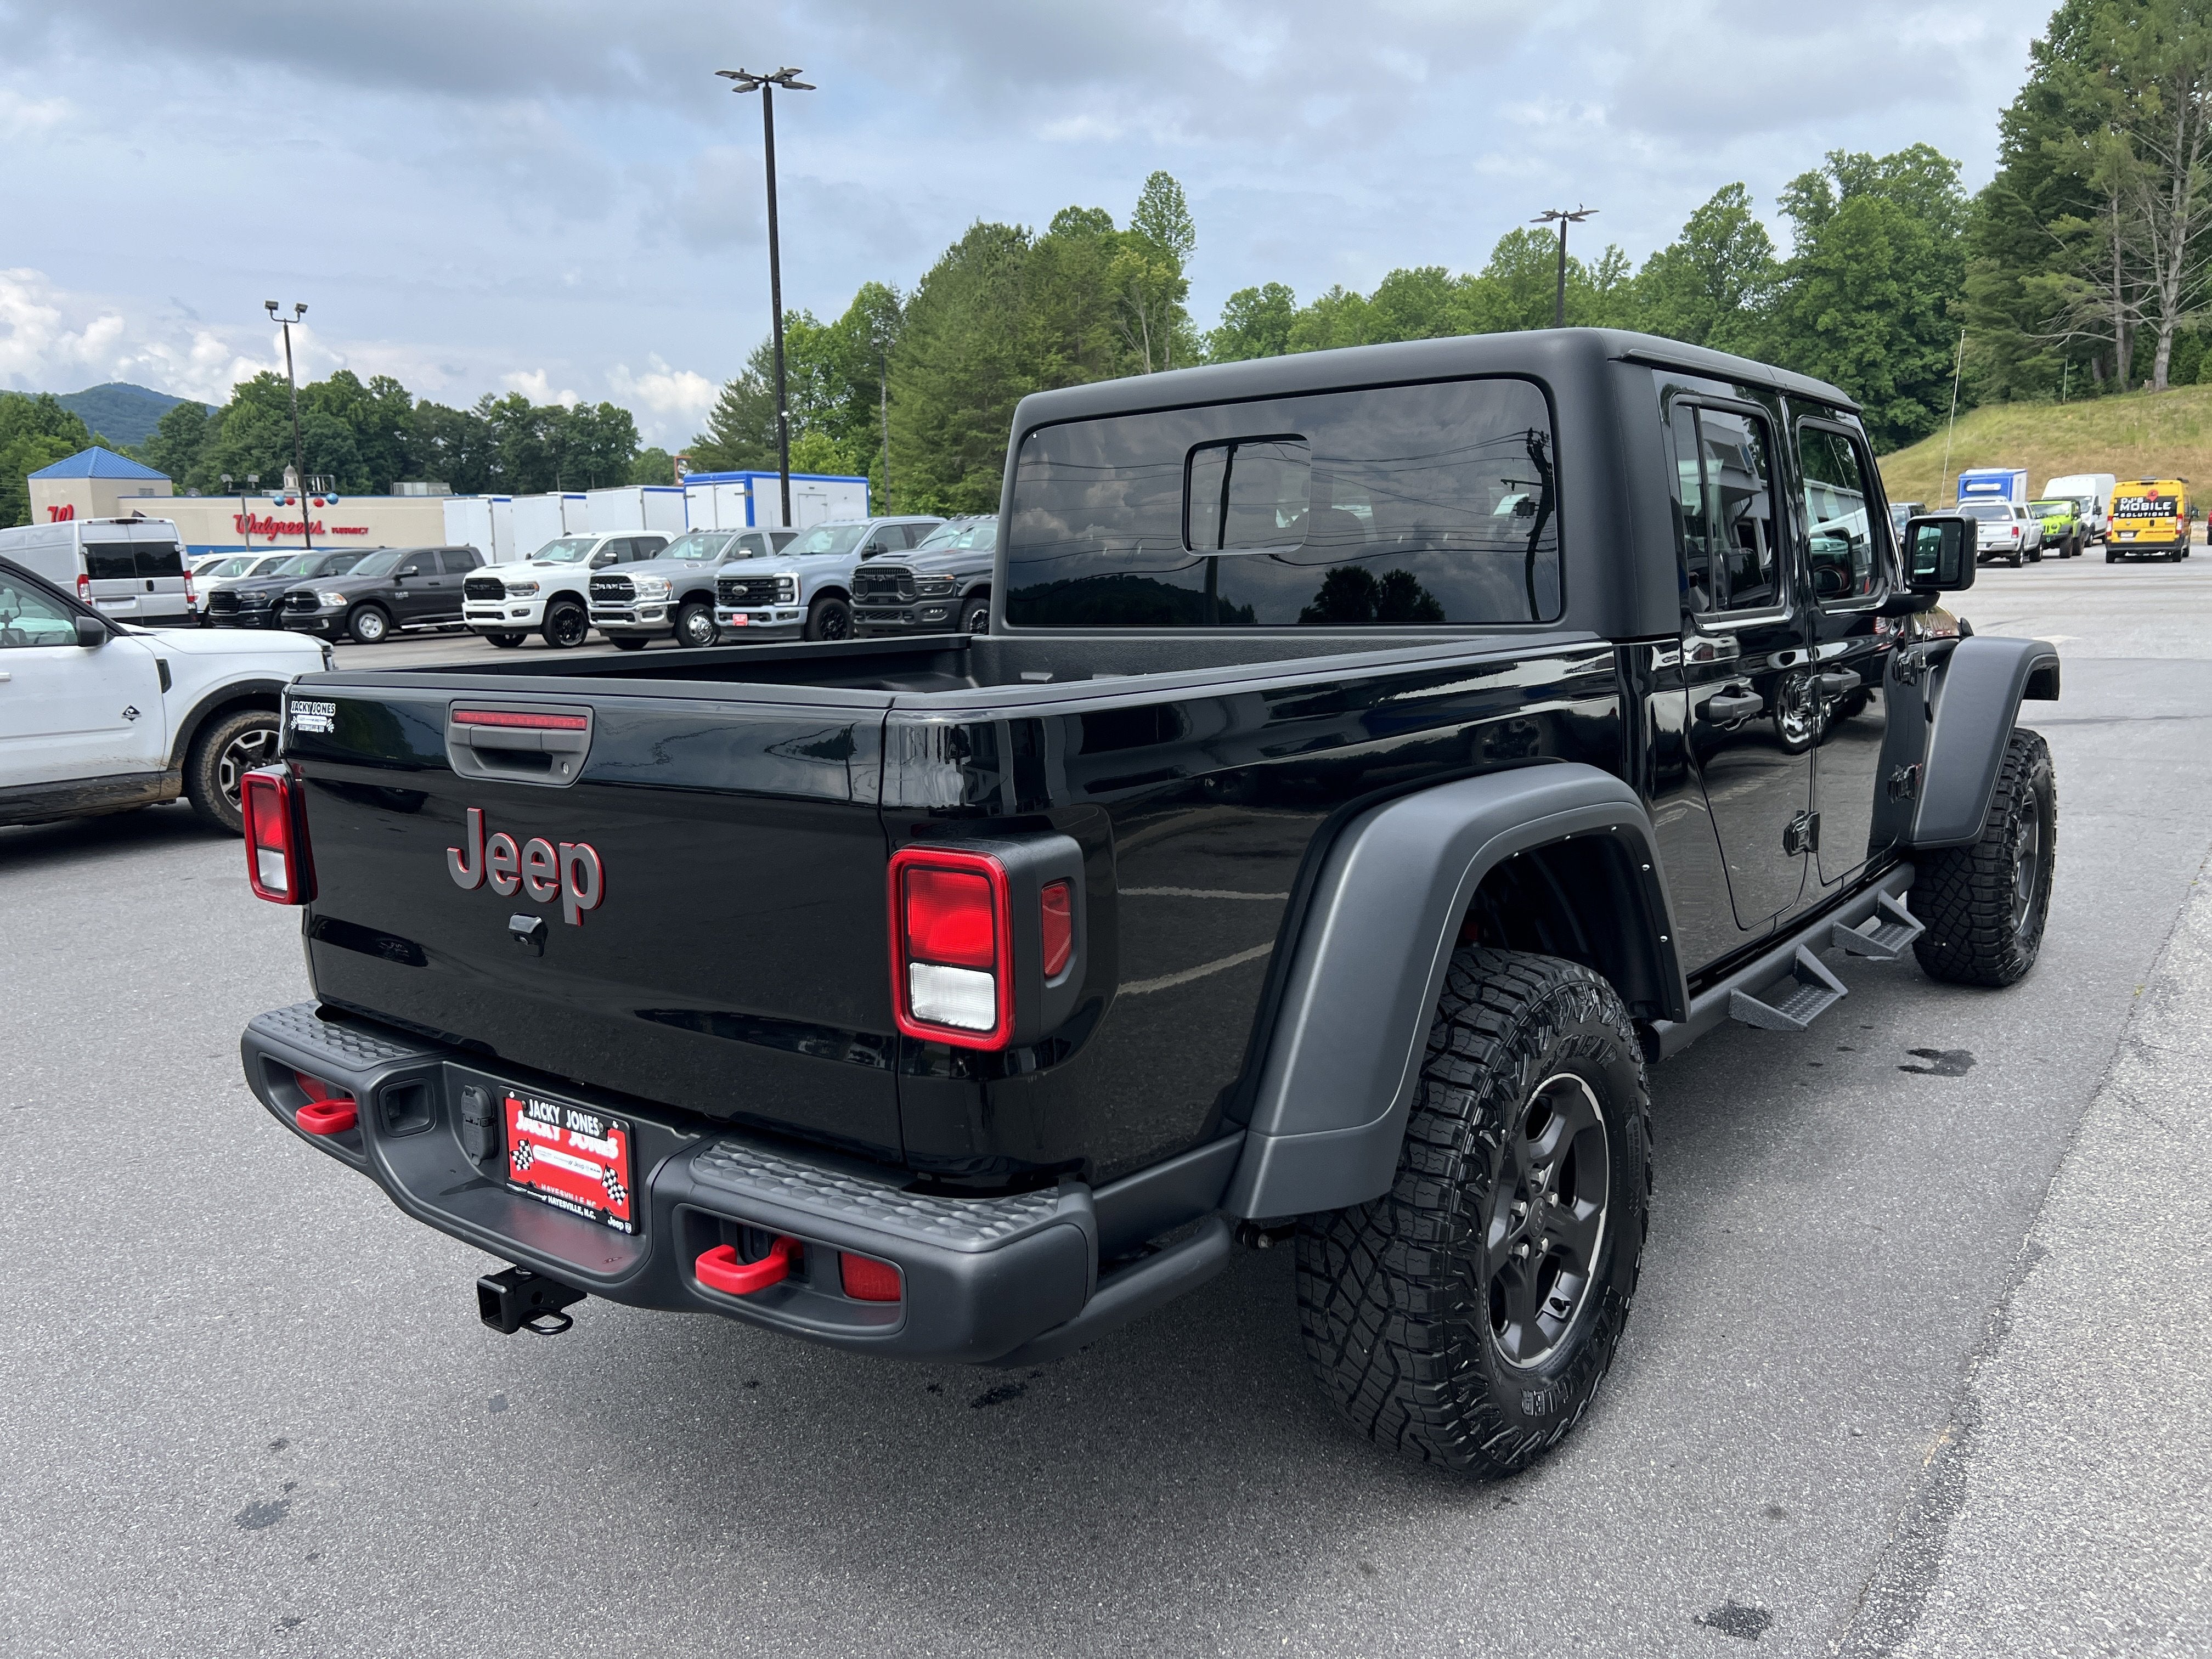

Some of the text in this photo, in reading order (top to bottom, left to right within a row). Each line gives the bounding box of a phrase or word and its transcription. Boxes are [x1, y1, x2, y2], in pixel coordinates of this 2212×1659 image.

[2120, 501, 2171, 511] MOBILE
[291, 701, 335, 716] JACKY JONES
[447, 807, 605, 927] Jeep
[528, 1099, 600, 1136] JACKY JONES
[607, 1216, 624, 1231] Jeep
